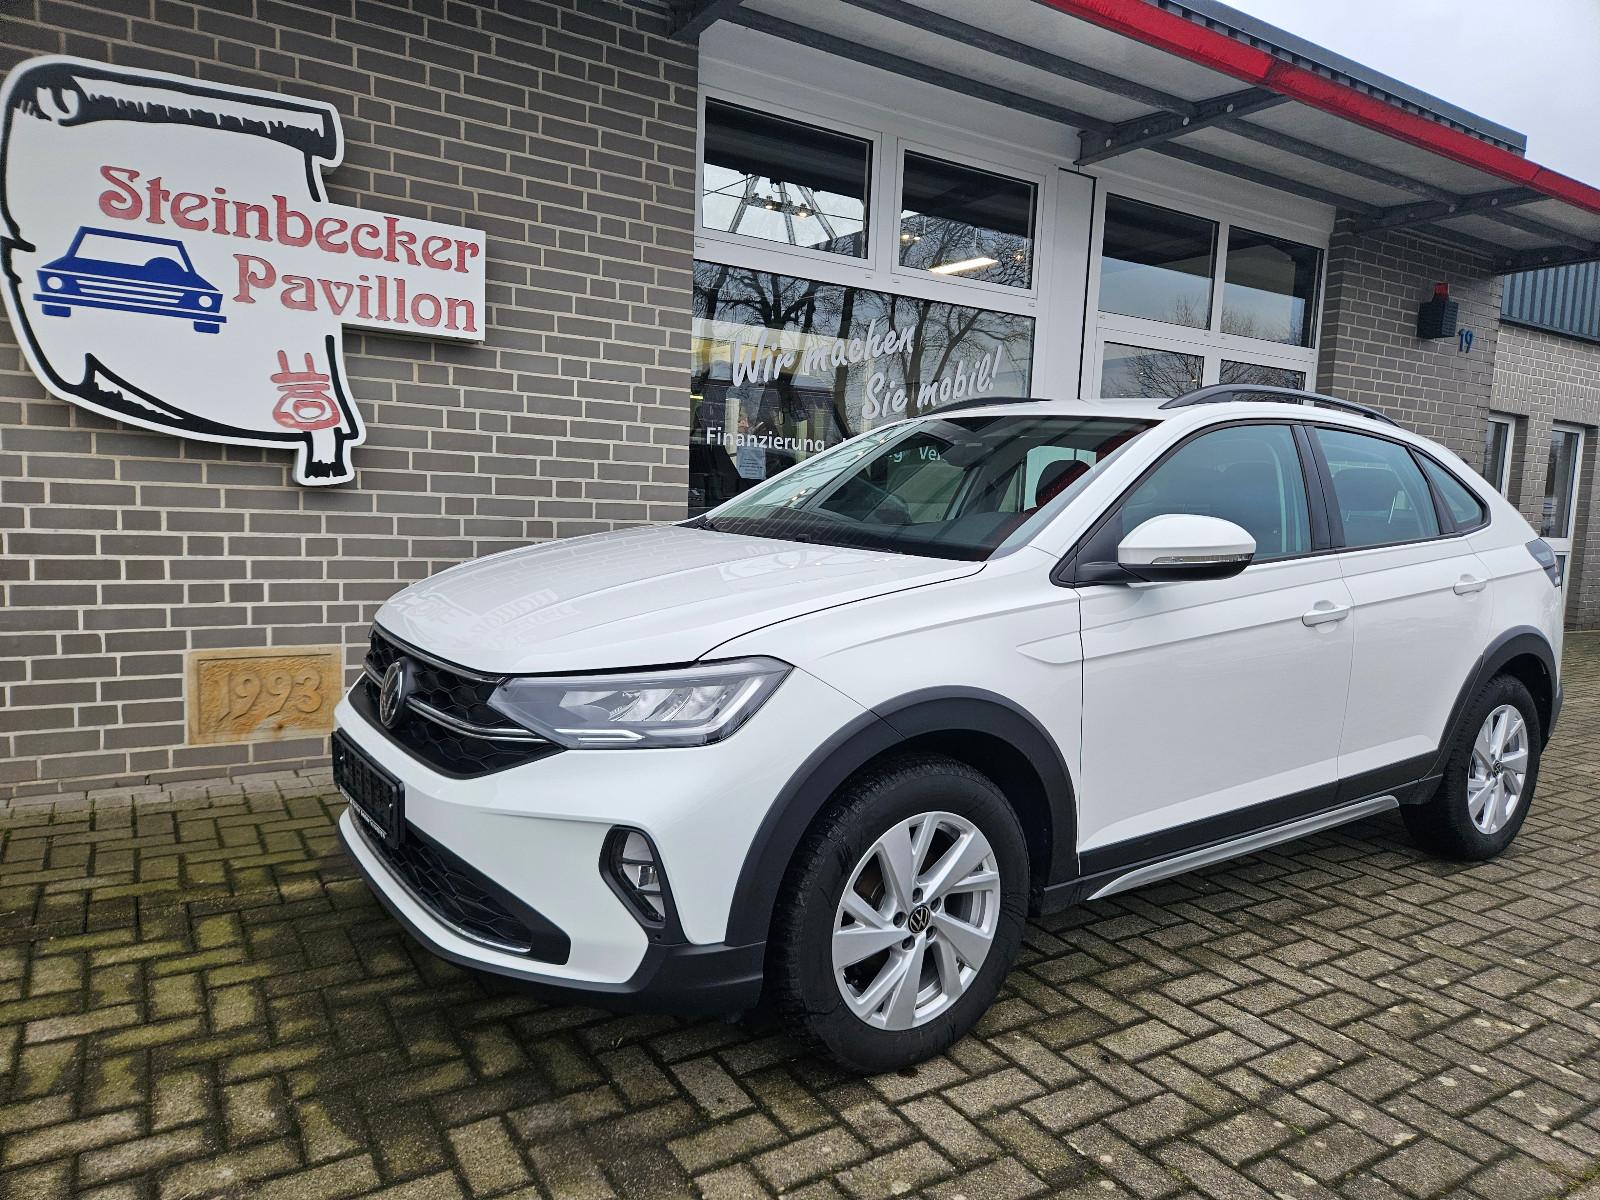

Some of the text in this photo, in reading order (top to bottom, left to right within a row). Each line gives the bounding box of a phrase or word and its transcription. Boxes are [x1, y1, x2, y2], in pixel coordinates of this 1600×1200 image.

[98, 164, 480, 274] Steinbecker
[232, 253, 478, 333] Pavillon
[731, 319, 916, 387] Wir machen
[1458, 328, 1473, 353] 19
[861, 345, 1001, 420] Sie mobil!
[705, 426, 826, 453] Finanzierung
[214, 666, 323, 723] 1993
